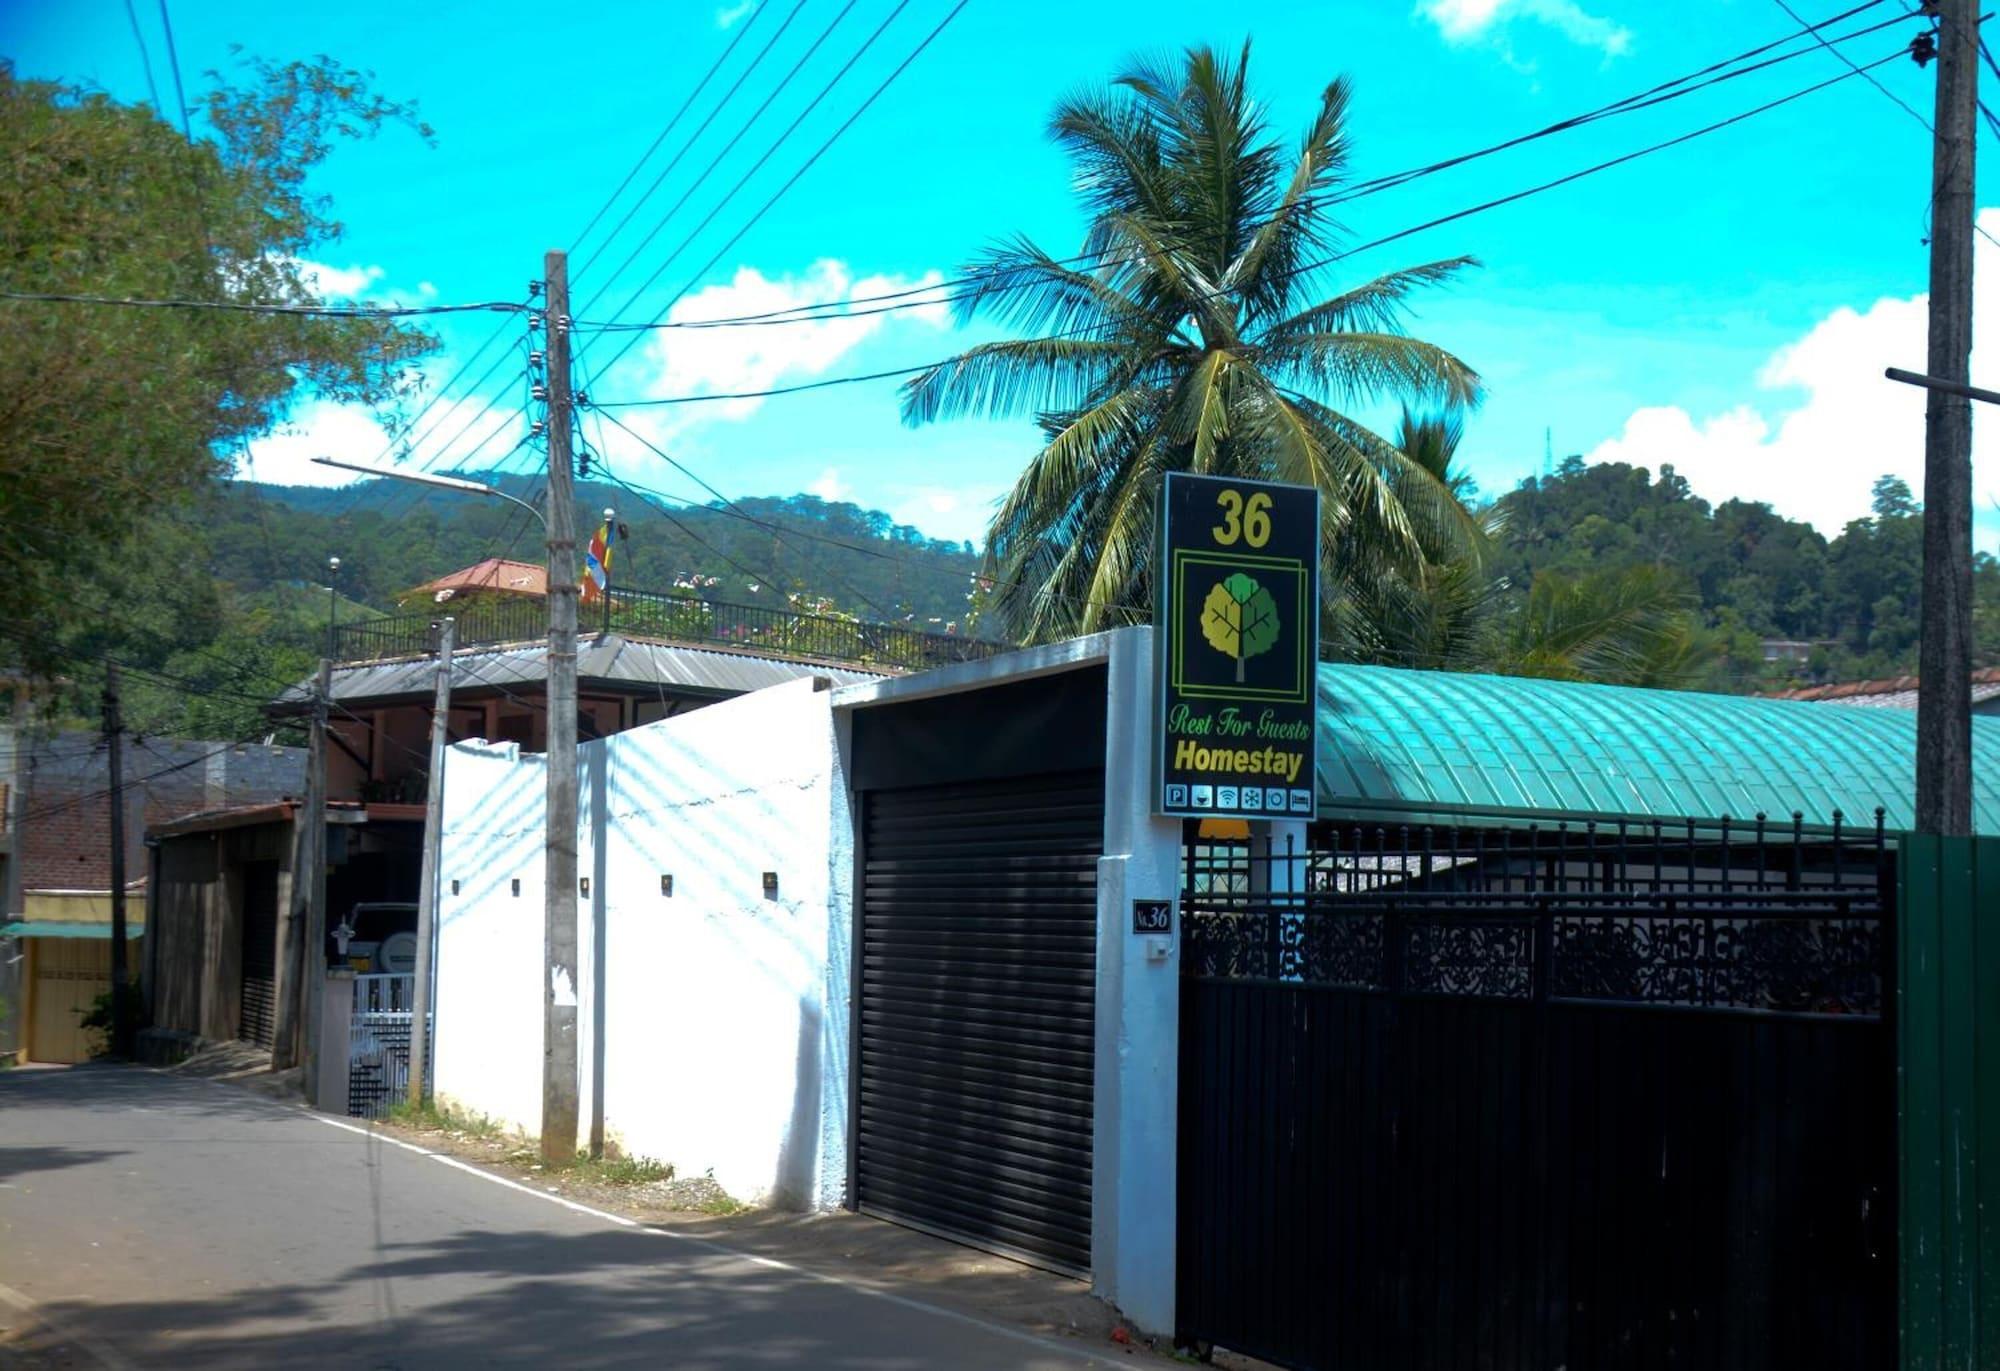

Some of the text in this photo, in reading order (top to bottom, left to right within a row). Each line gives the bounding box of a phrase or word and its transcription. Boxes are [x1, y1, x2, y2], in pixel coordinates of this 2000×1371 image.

[1212, 489, 1273, 548] 36
[1168, 703, 1311, 740] Rest For Guests
[1174, 740, 1303, 783] Homestay
